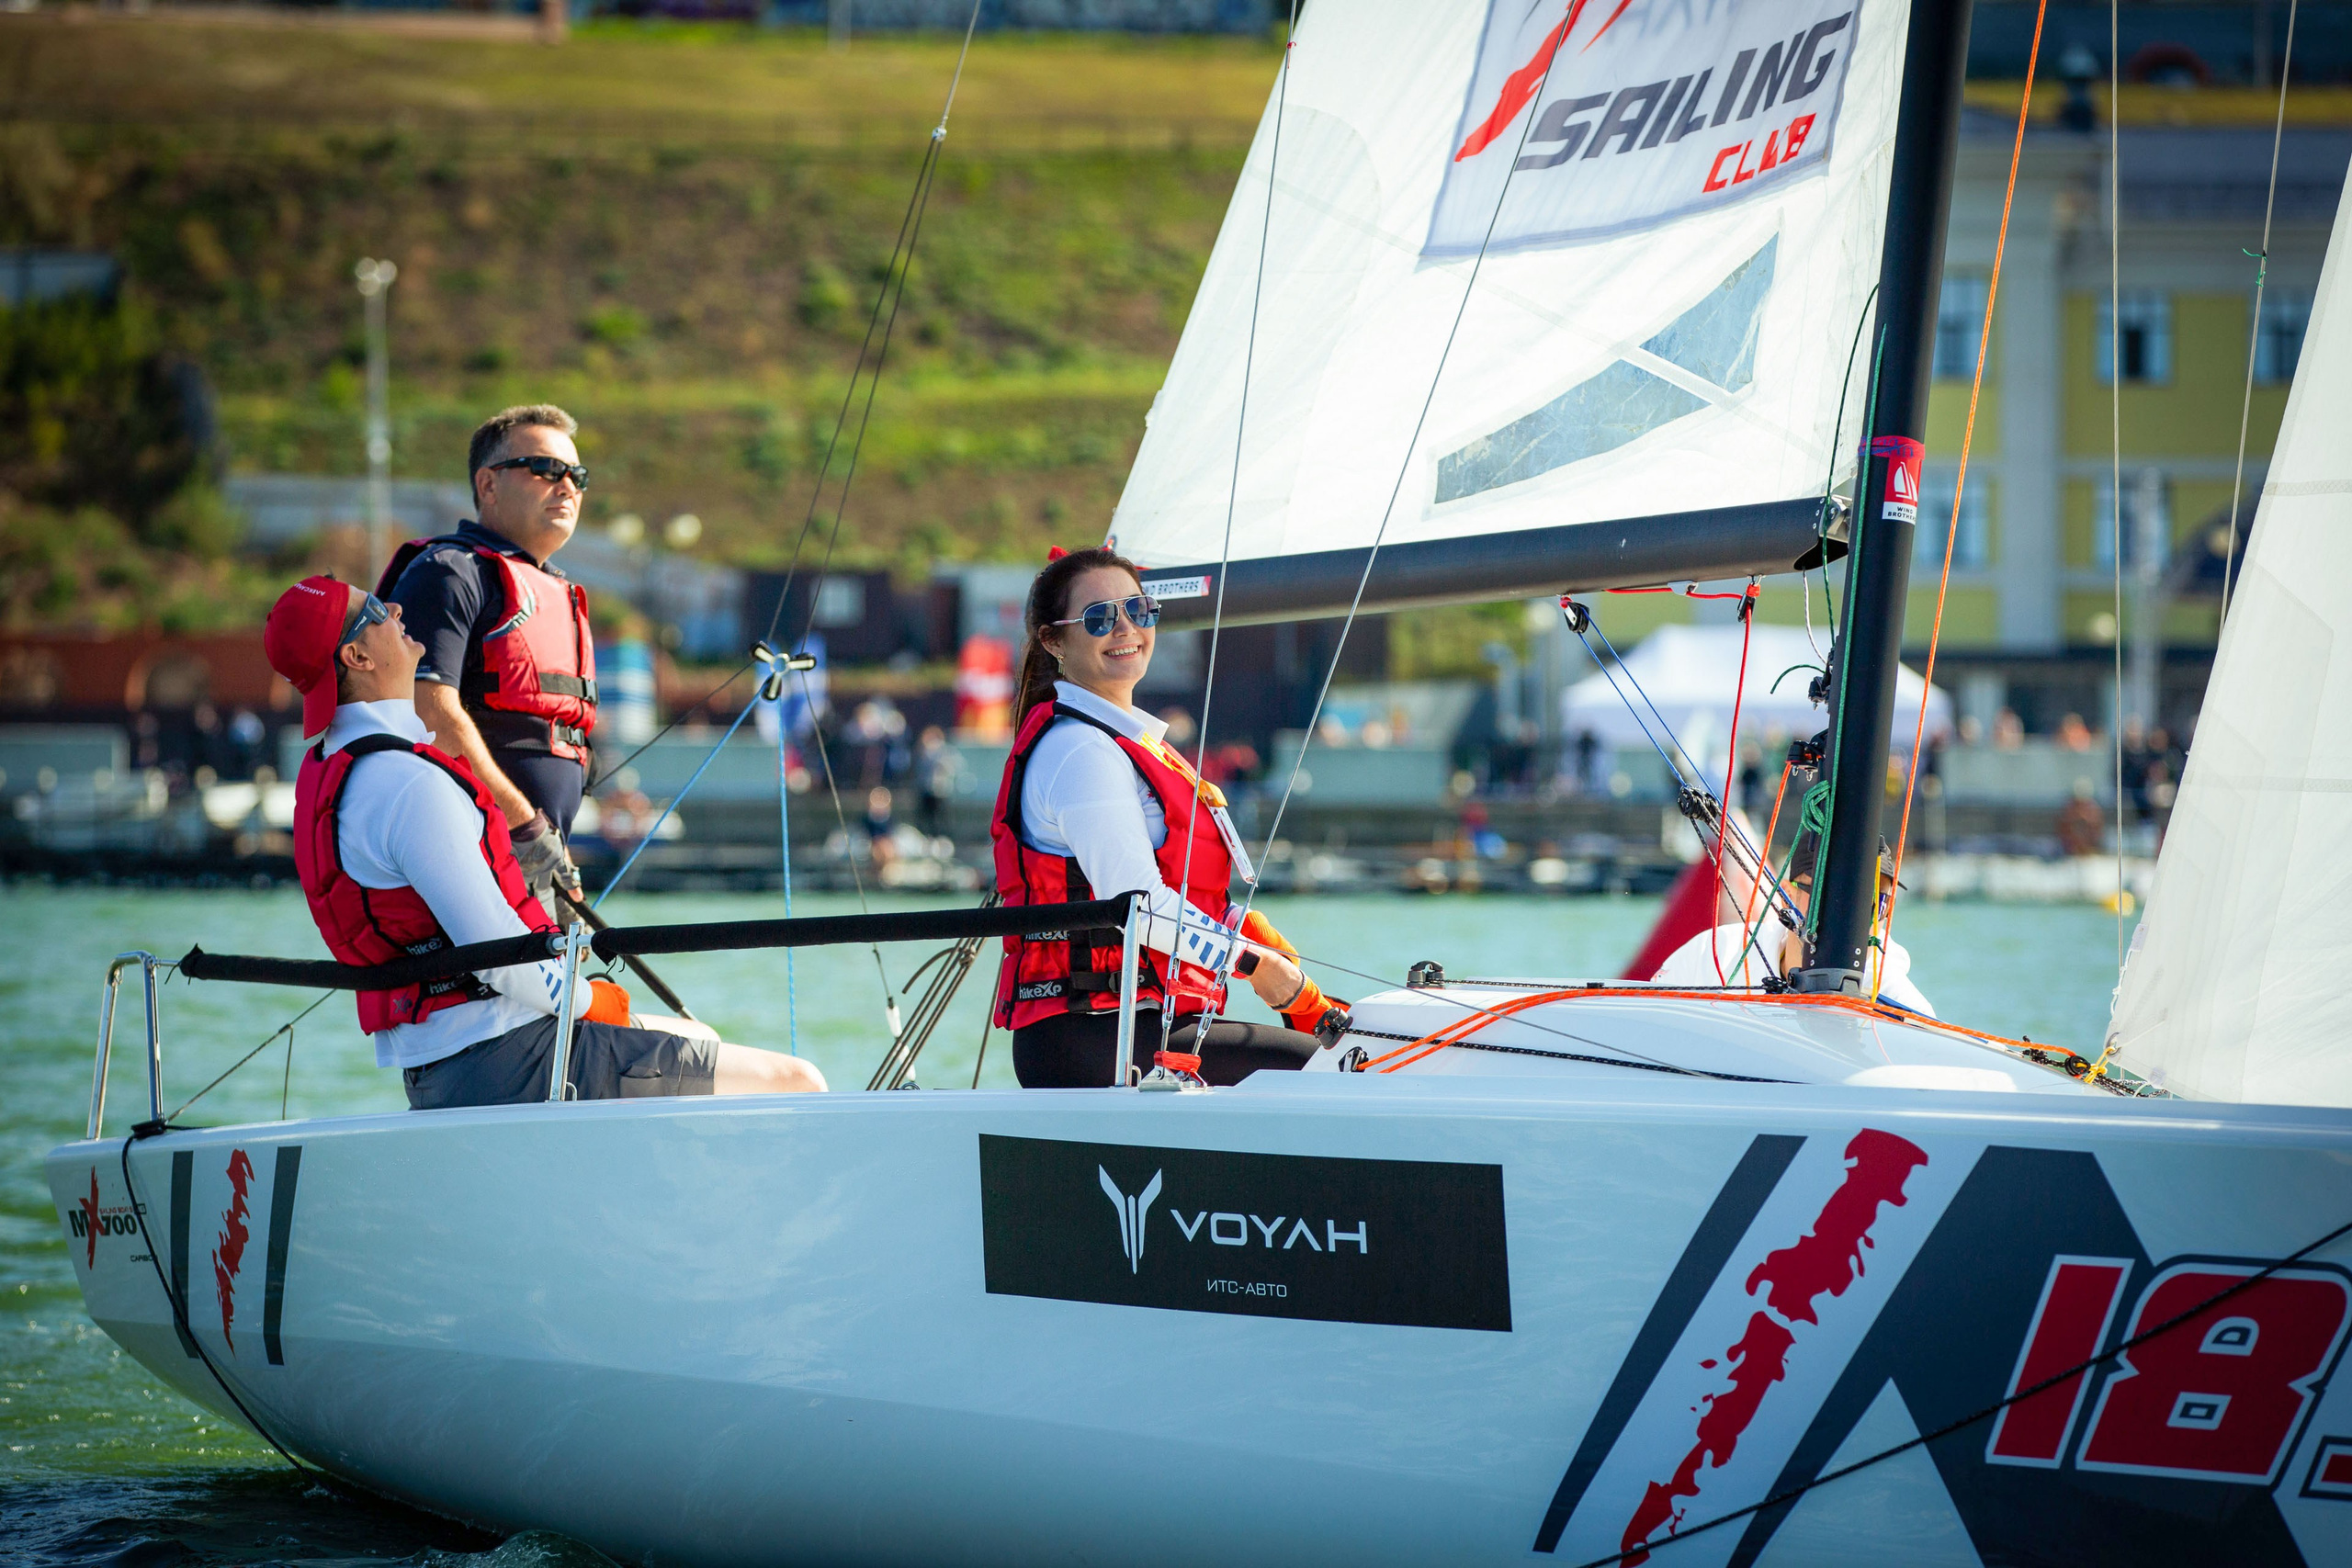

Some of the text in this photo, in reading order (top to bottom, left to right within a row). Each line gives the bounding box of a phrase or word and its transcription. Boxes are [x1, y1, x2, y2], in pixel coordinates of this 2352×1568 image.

[1514, 11, 1852, 172] SAILING
[1896, 506, 1914, 514] WIND
[1159, 581, 1200, 595] BROTHERS
[1170, 1209, 1368, 1254] VOYAH
[130, 1254, 159, 1263] CARBO
[1206, 1279, 1288, 1298] ИТС-АВТО
[1984, 1253, 2352, 1503] 18
